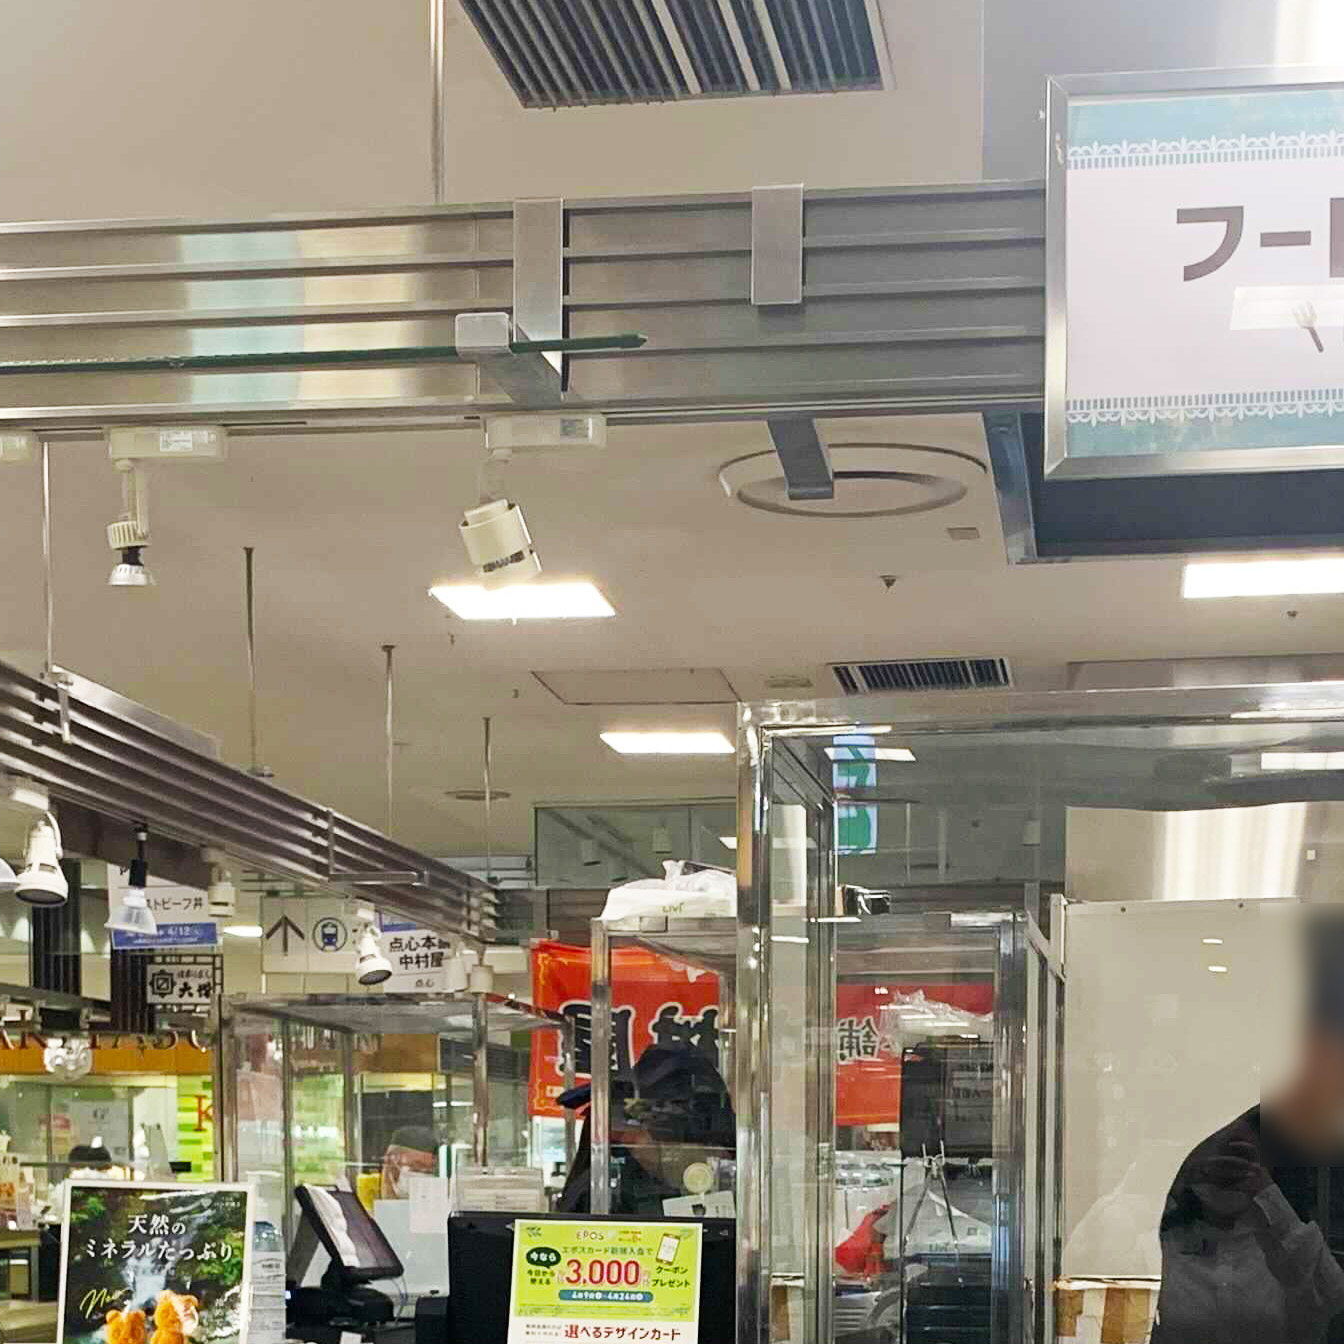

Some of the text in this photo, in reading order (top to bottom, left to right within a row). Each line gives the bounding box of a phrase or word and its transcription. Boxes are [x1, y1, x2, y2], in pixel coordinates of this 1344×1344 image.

[126, 1213, 187, 1236] 天然の
[85, 1237, 234, 1263] ミネラルたっぷり
[564, 1324, 681, 1342] 選べるデザインカード
